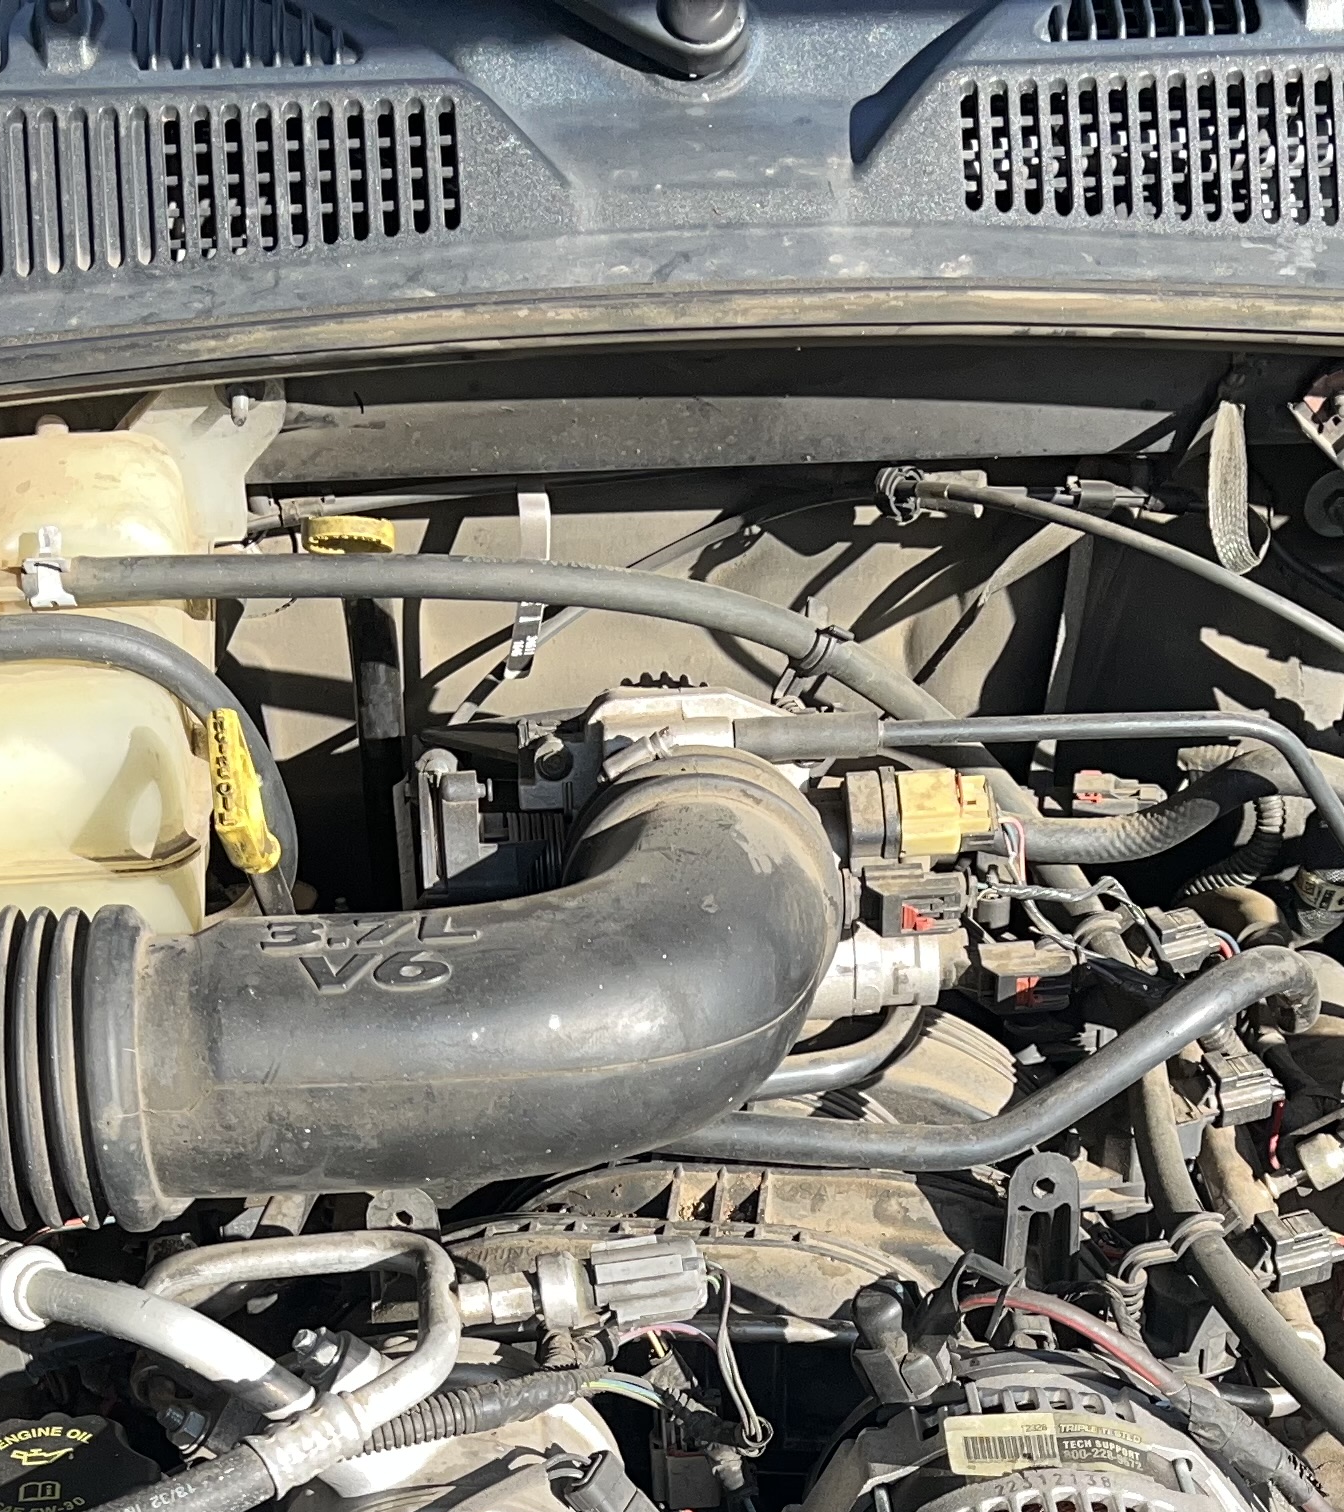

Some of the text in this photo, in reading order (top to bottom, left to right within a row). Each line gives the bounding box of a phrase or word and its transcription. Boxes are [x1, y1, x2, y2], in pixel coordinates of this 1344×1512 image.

[299, 951, 452, 995] V6
[66, 1428, 93, 1445] OIL
[1062, 1440, 1141, 1461] TECH SUPPORT
